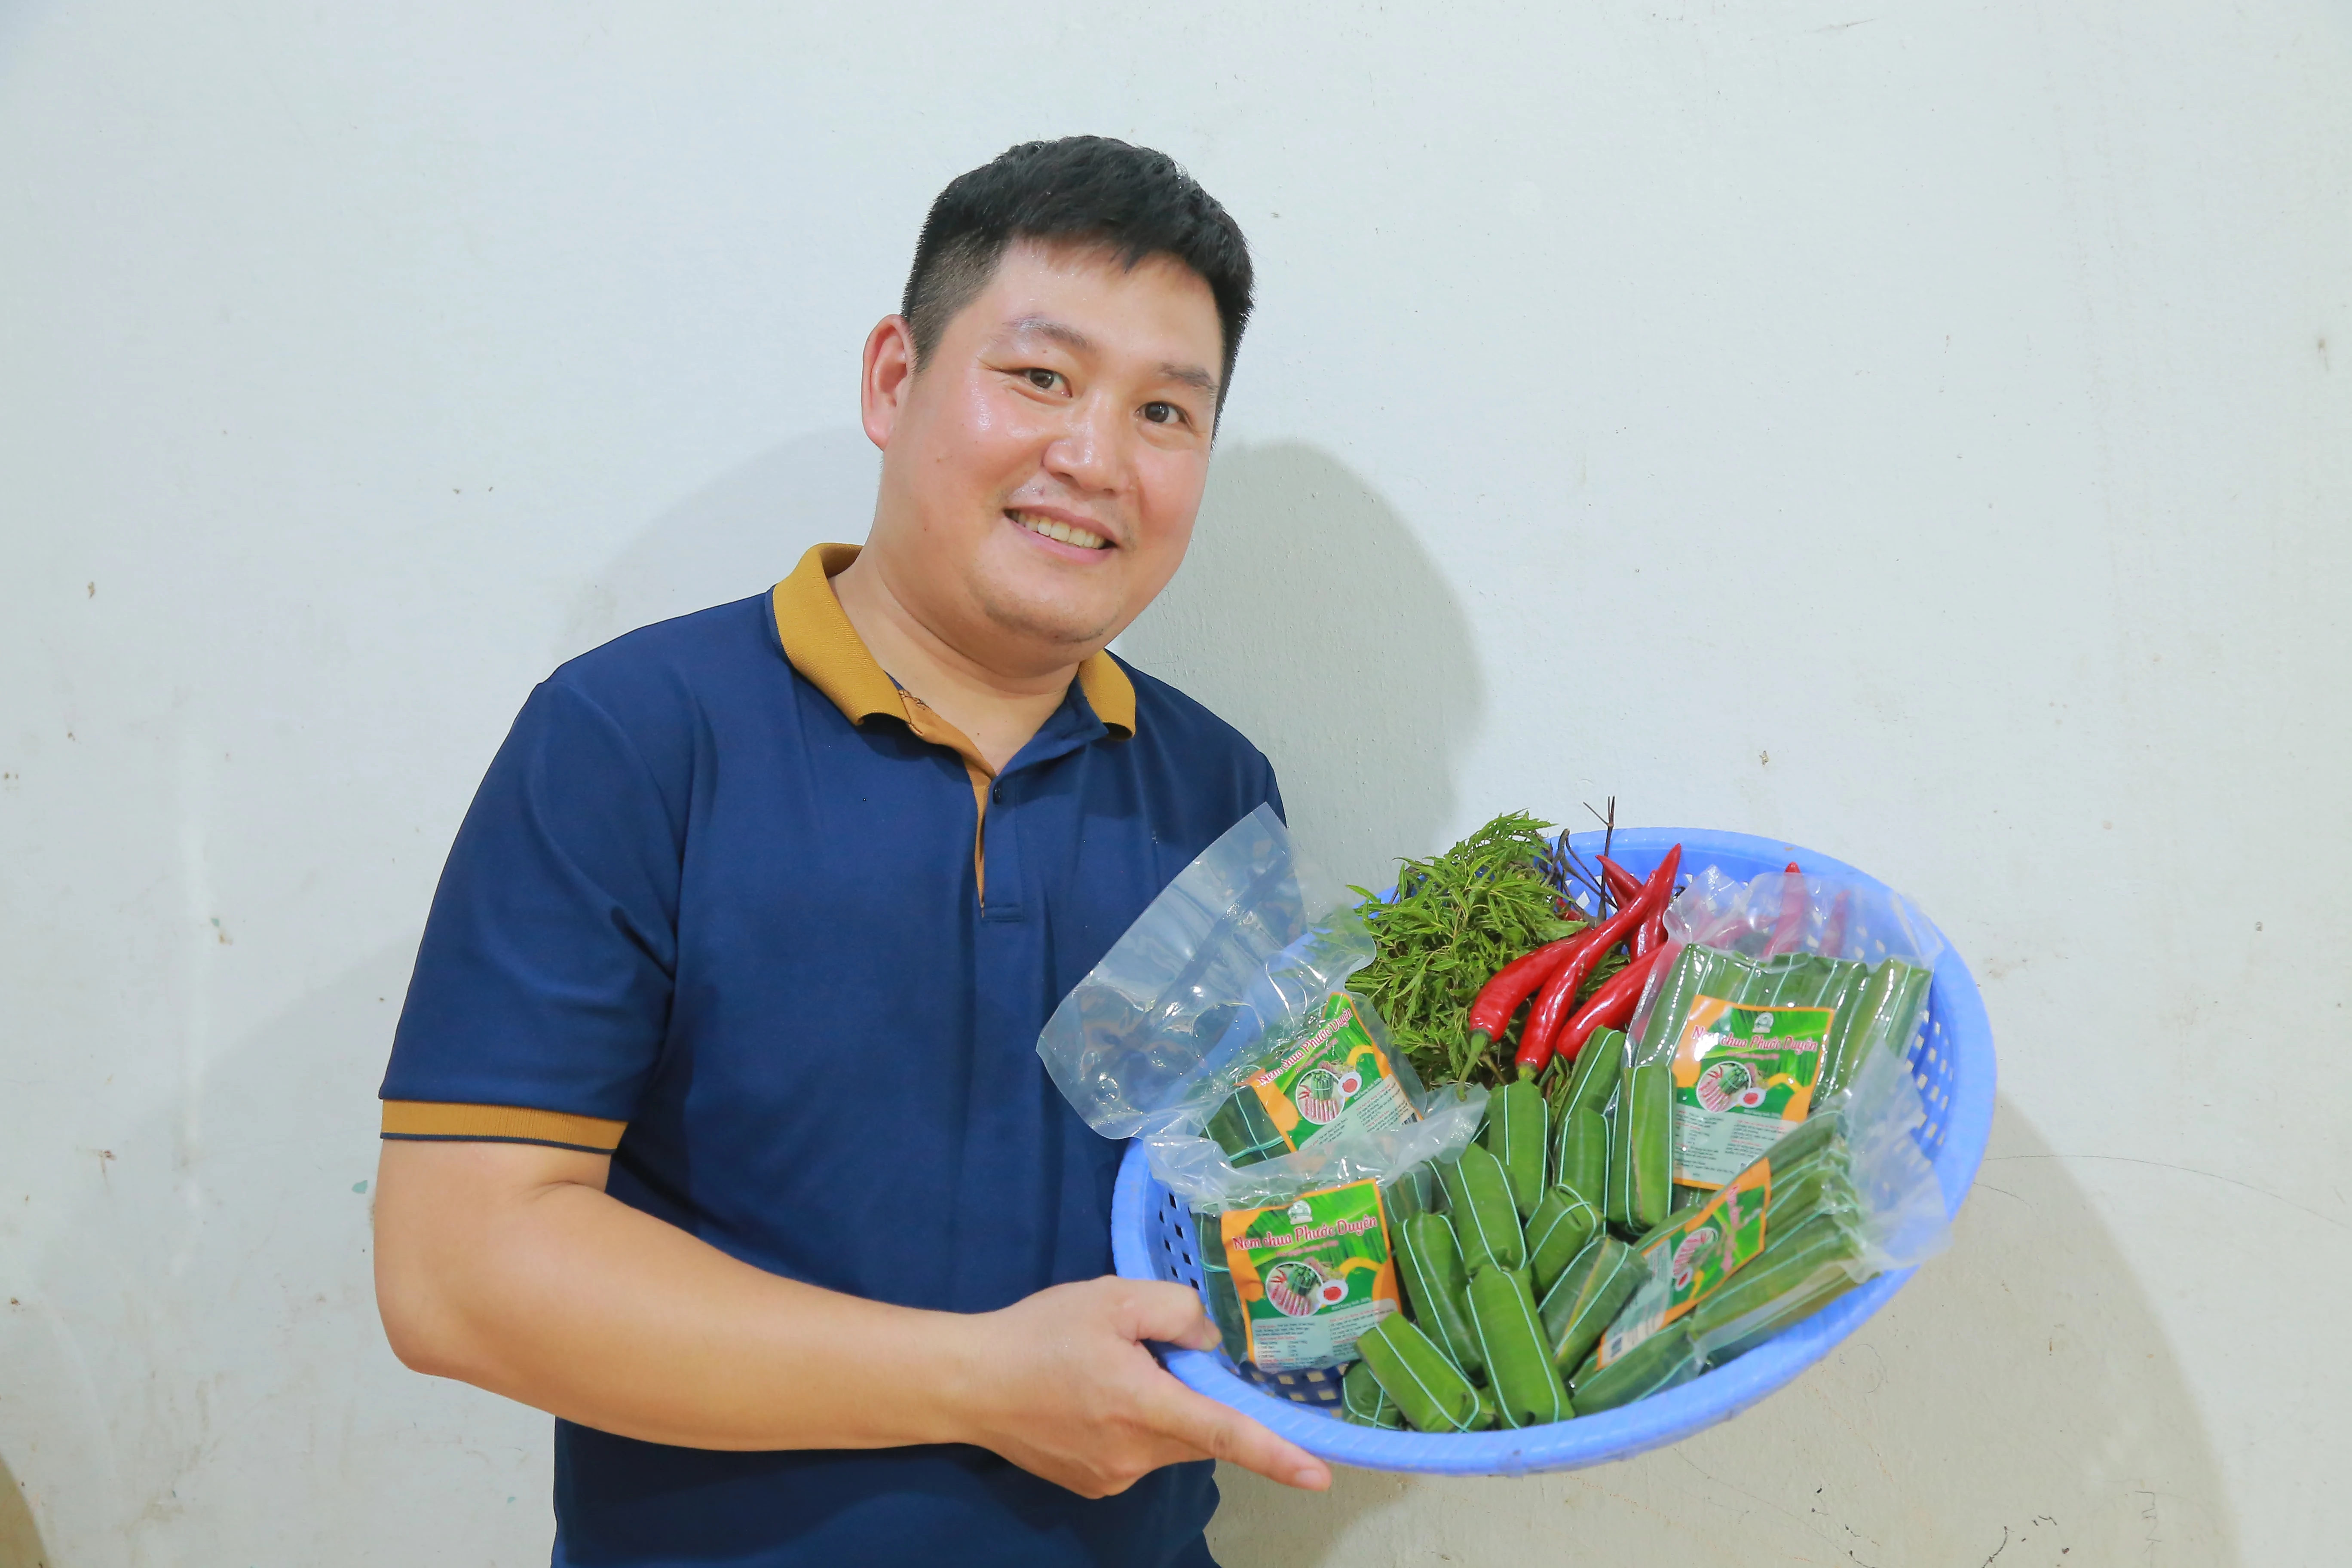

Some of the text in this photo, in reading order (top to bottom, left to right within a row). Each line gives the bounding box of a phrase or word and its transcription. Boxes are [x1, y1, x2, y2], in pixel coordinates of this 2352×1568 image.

[1721, 1032, 1748, 1048] chua
[1257, 1068, 1283, 1086] Nem
[1232, 1236, 1261, 1250] Nem
[1263, 1231, 1292, 1246] chua
[1294, 1224, 1335, 1243] Phước
[1336, 1213, 1378, 1236] Duyên
